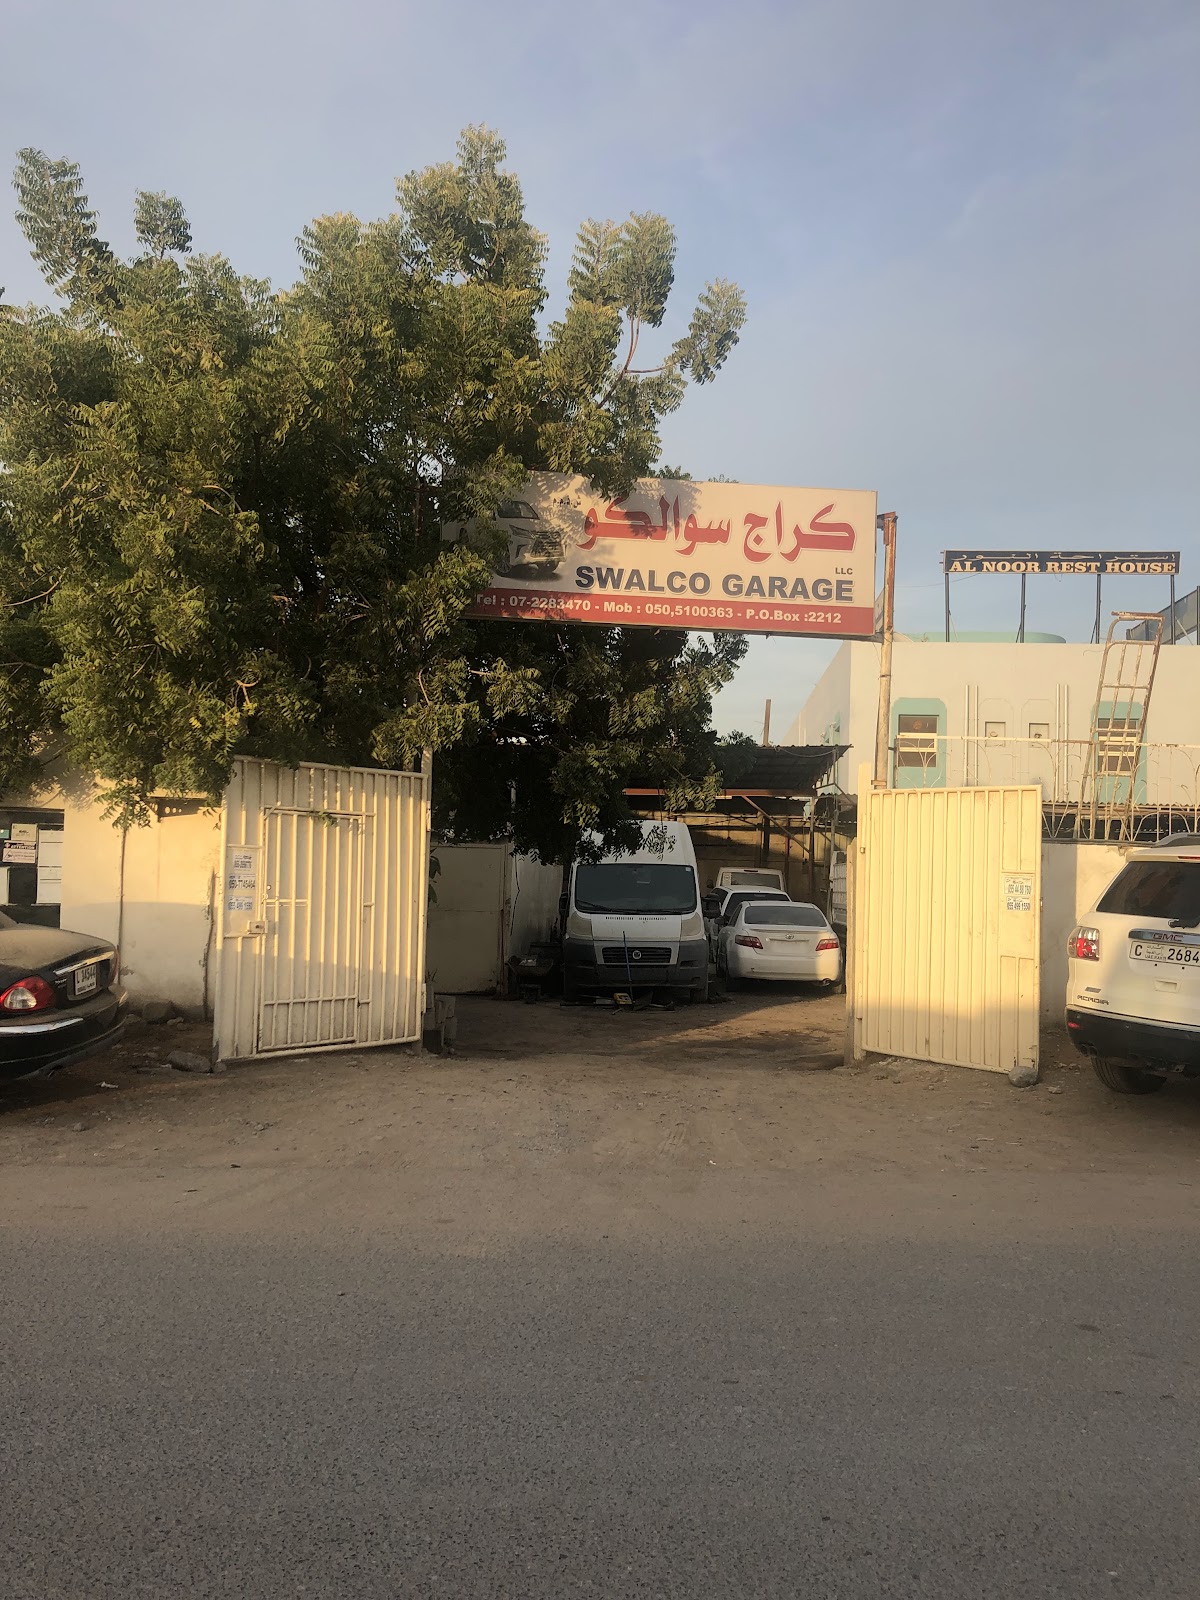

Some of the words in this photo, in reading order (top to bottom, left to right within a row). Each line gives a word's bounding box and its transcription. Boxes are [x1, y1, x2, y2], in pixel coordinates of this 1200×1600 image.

[575, 495, 732, 557] سوالكو
[743, 500, 857, 563] كراج
[951, 552, 1039, 561] النور
[835, 567, 853, 575] LLC
[948, 561, 977, 572] AL
[981, 561, 1041, 573] NOOR
[1045, 561, 1101, 573] REST
[1105, 562, 1176, 573] HOUSE
[575, 565, 711, 595] SWALCO
[722, 573, 854, 602] GARAGE
[509, 594, 591, 611] 07-2283470
[603, 601, 633, 613] Mob
[645, 603, 734, 618] 050,5100363
[746, 609, 800, 622] P.O.Box
[1152, 933, 1184, 942] GMC
[1134, 944, 1143, 957] C
[1167, 948, 1200, 964] 2684
[1076, 994, 1110, 1006] ACADIA
